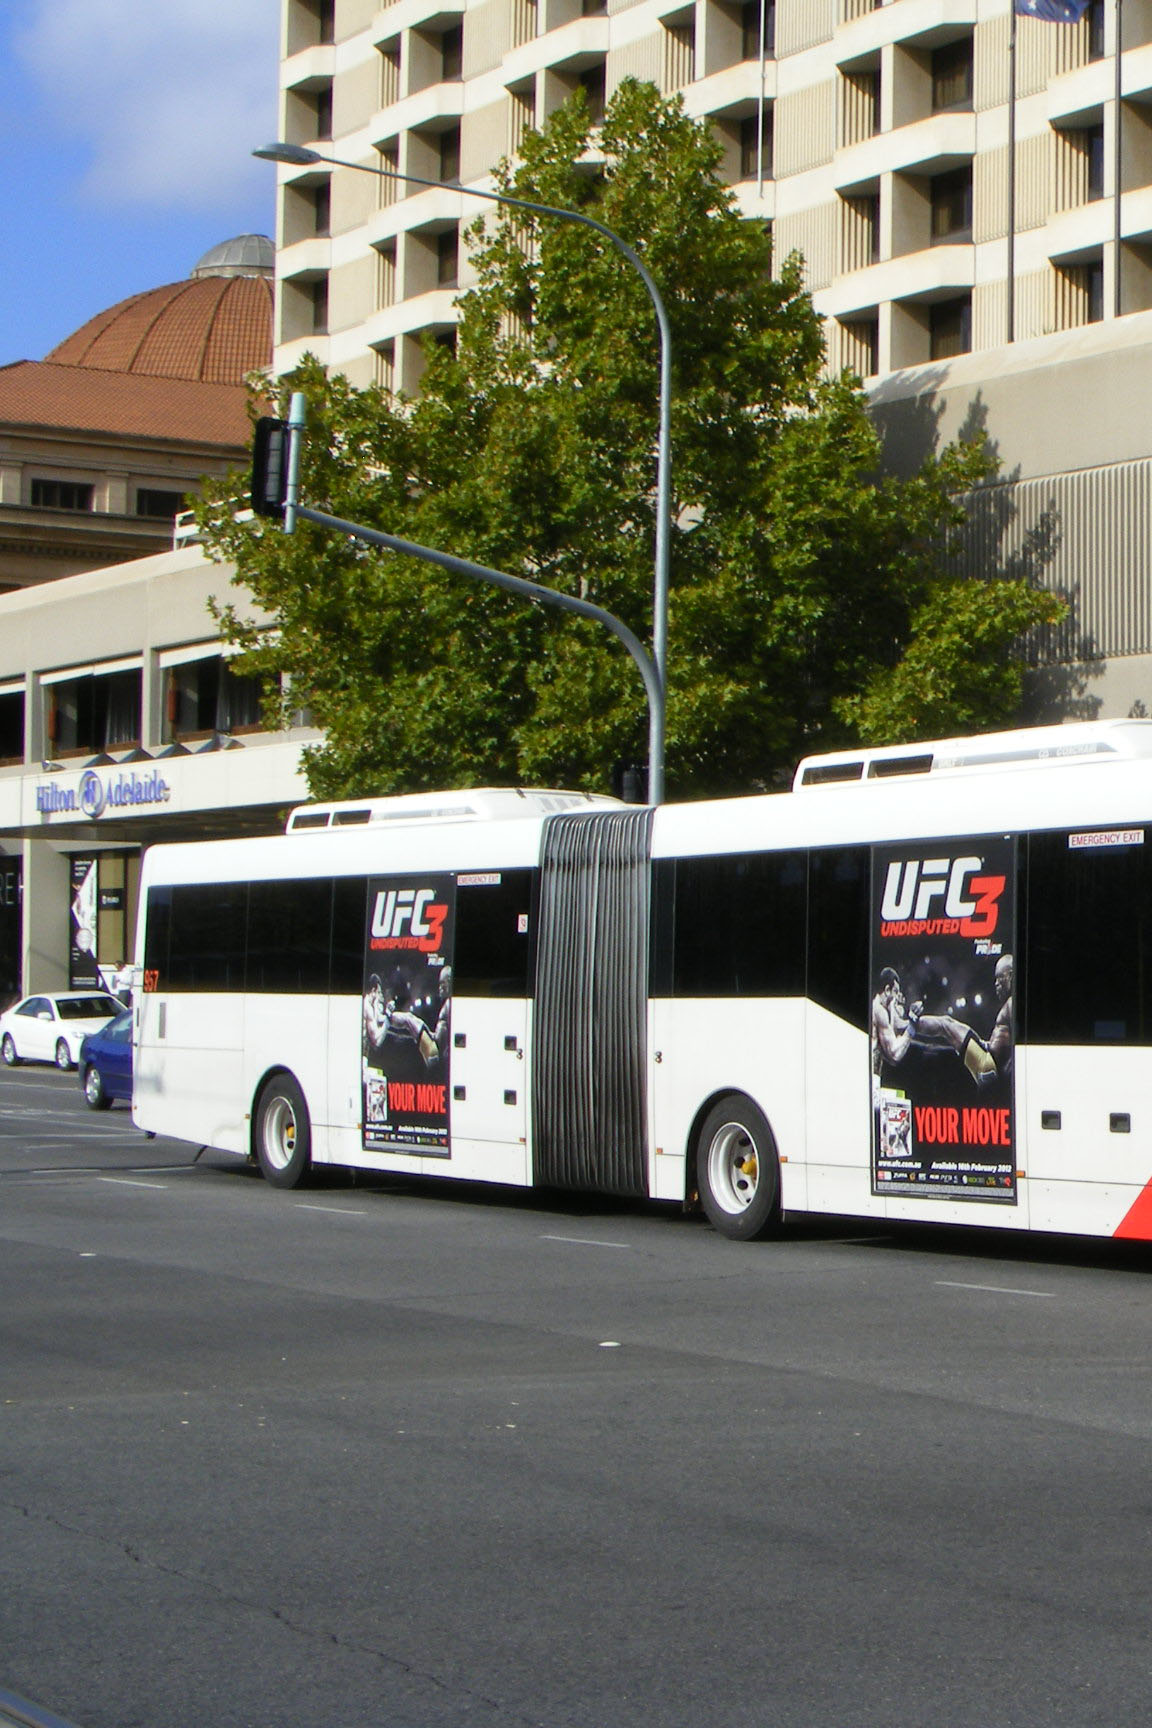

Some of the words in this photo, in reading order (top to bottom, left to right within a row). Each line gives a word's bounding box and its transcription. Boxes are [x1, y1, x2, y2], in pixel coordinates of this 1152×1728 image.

[36, 782, 77, 812] Hilton
[106, 770, 168, 806] Adelaide
[1071, 833, 1120, 846] EMERGENCY
[1123, 832, 1141, 843] EXIT
[458, 876, 486, 885] EMERGENCY
[881, 856, 982, 920] UFC
[371, 889, 435, 937] UFC
[881, 919, 961, 937] UNDISPUTED
[960, 875, 1006, 937] 3
[371, 937, 421, 950] UNDISPUTED
[419, 904, 448, 952] 3
[387, 1082, 415, 1111] YOUR
[417, 1084, 446, 1113] MOVE
[914, 1107, 959, 1143] YOUR
[962, 1108, 1011, 1146] MOVE
[931, 1161, 957, 1170] Available
[971, 1163, 998, 1173] February
